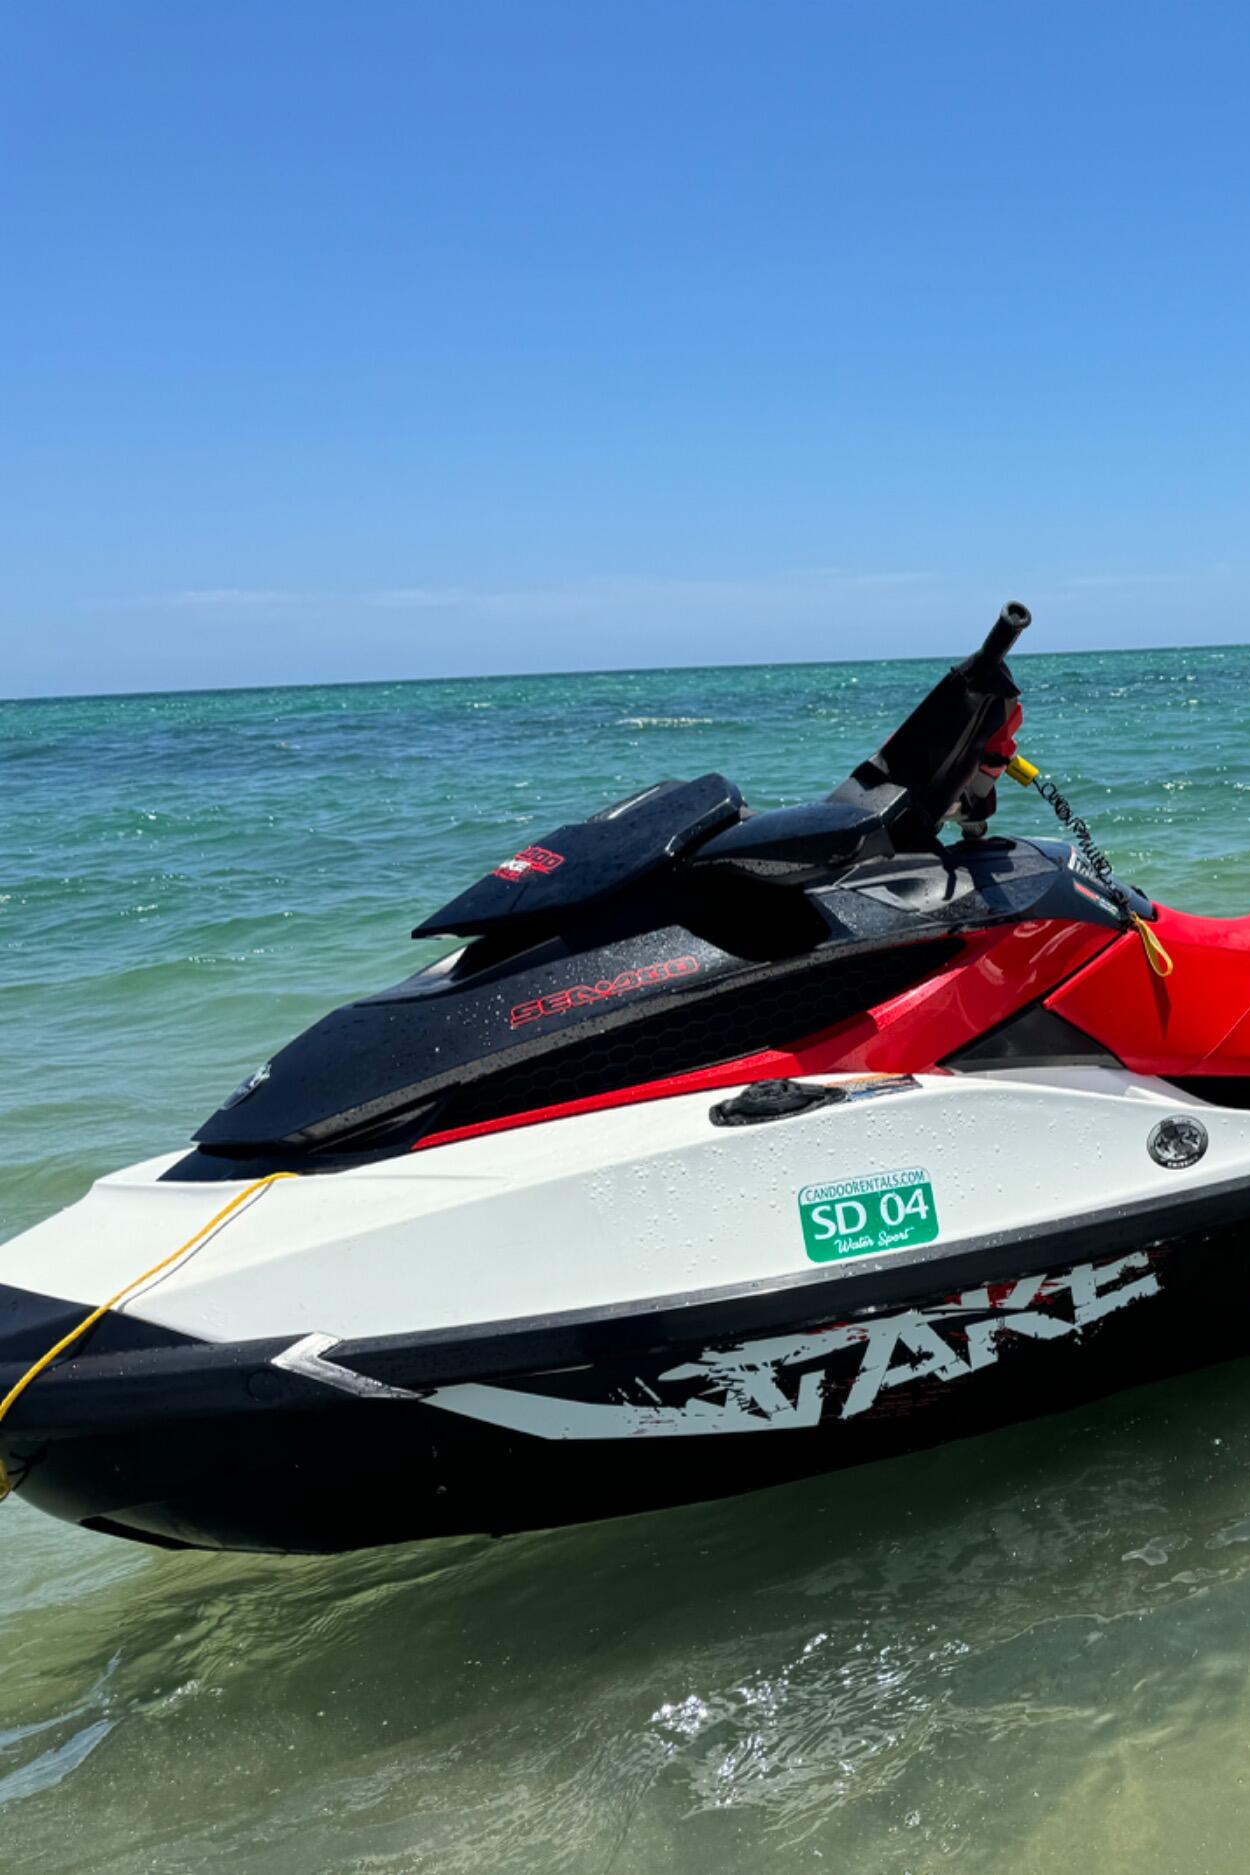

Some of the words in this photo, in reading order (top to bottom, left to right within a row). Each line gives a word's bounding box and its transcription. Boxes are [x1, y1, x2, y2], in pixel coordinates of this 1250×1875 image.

[805, 1170, 926, 1202] CANDOORENTALS.COM
[811, 1200, 867, 1240] SD
[879, 1188, 929, 1227] 04
[834, 1235, 875, 1254] Water
[877, 1226, 916, 1248] Sport
